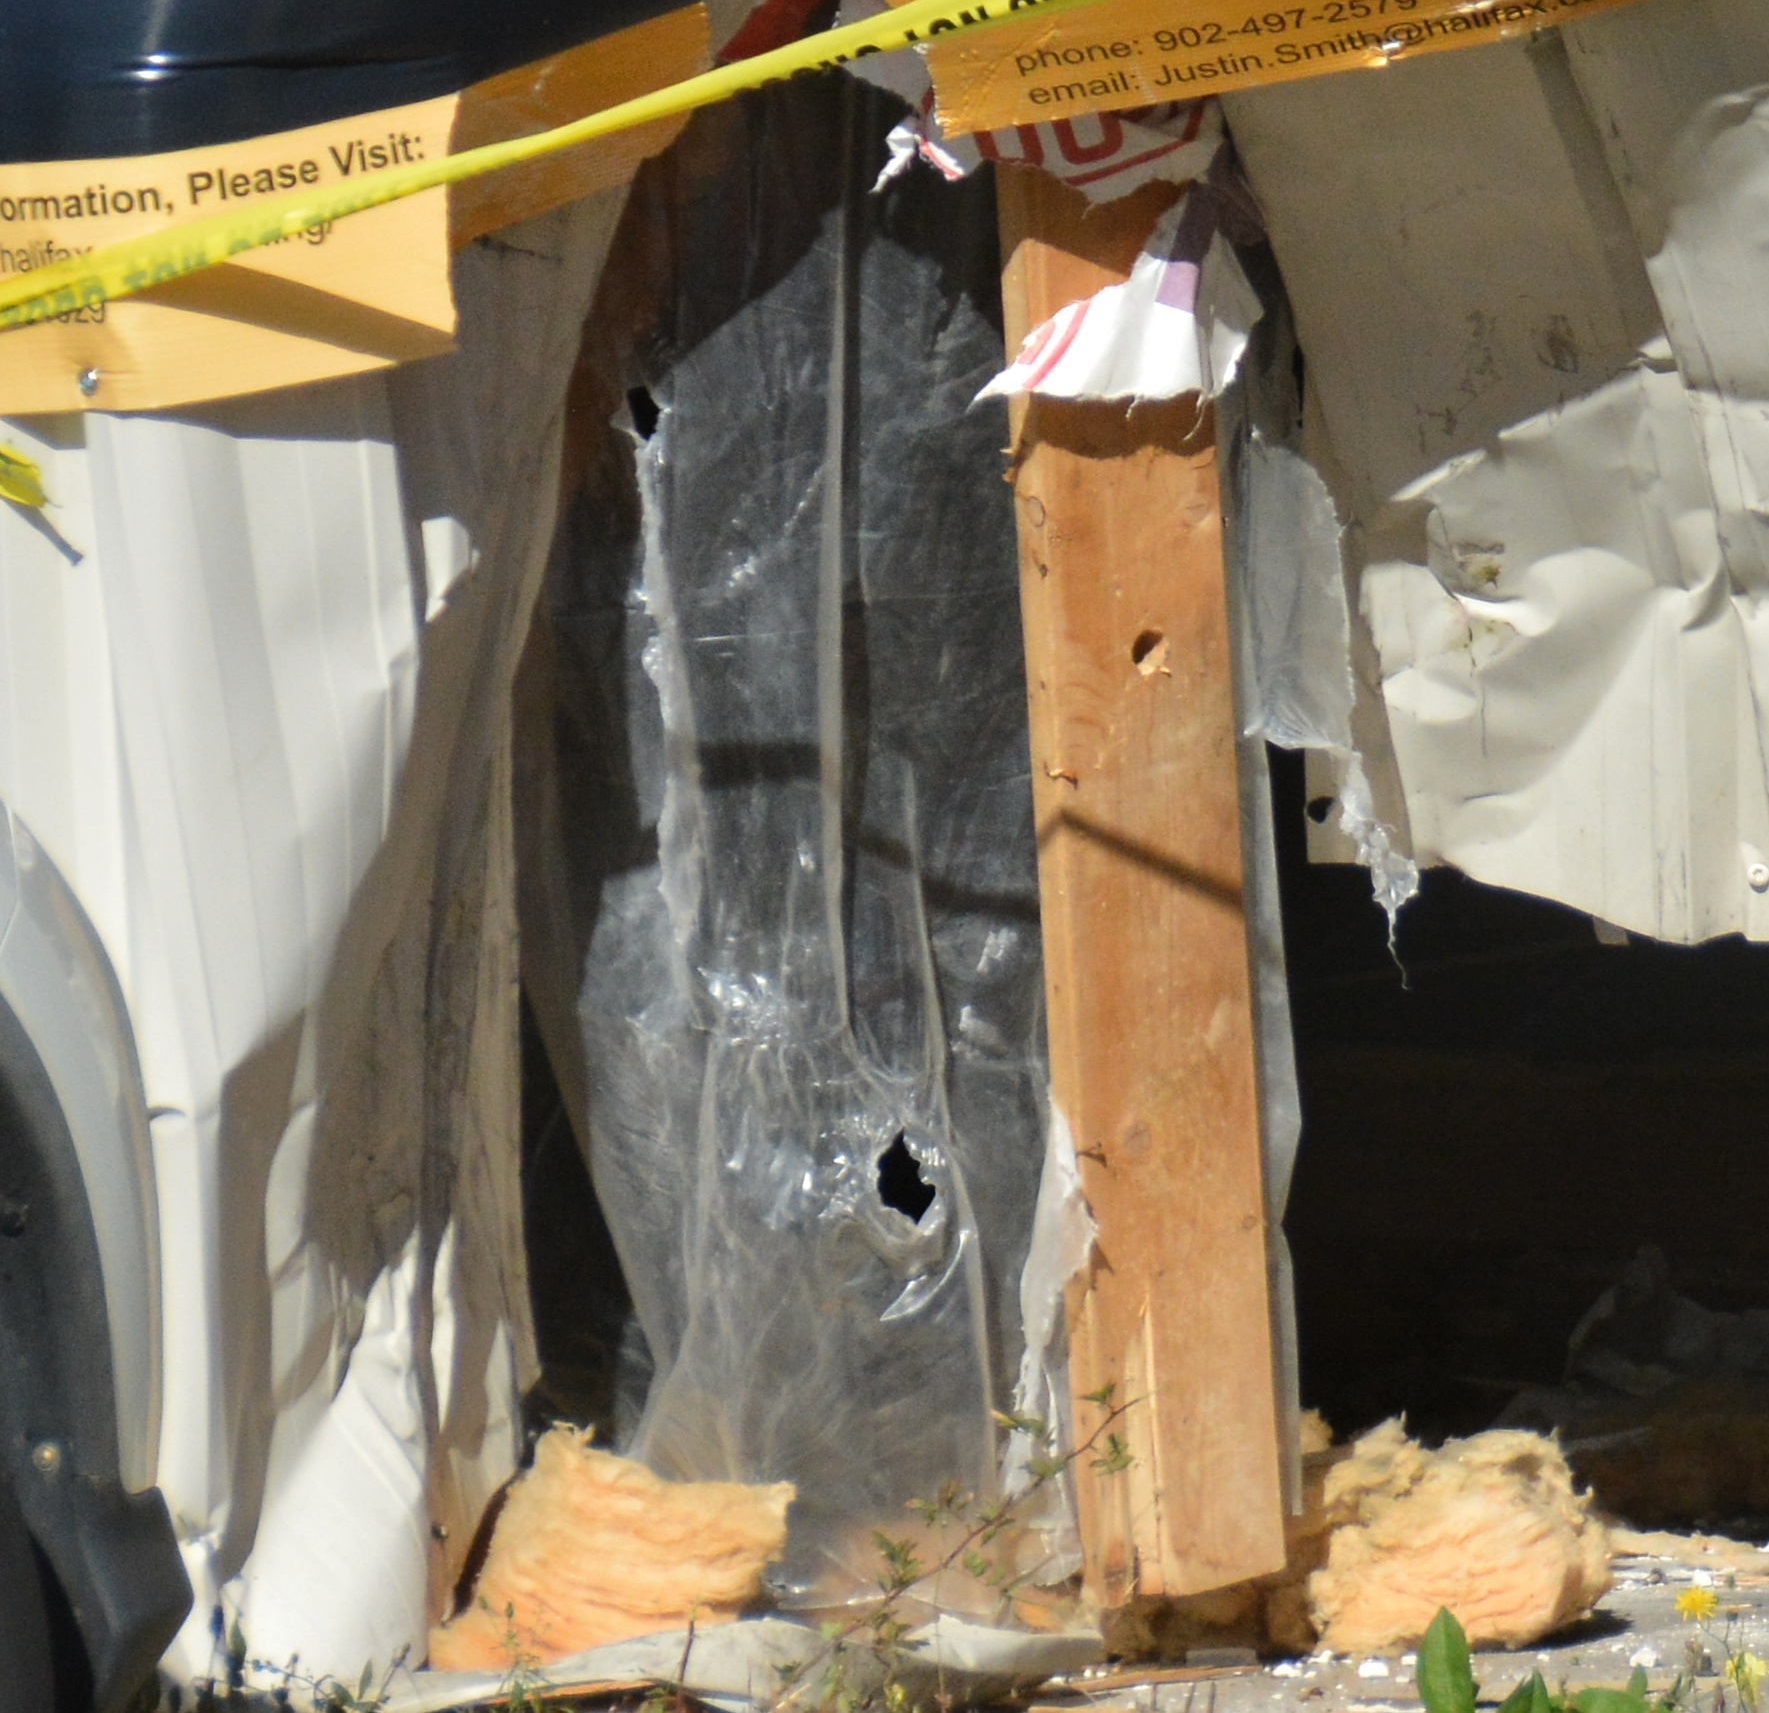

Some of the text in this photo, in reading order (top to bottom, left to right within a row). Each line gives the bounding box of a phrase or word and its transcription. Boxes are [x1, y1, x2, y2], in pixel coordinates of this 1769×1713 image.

[1015, 36, 1142, 77] phone:
[1027, 70, 1141, 107] email:
[0, 131, 427, 222] ormation, Please Visit:
